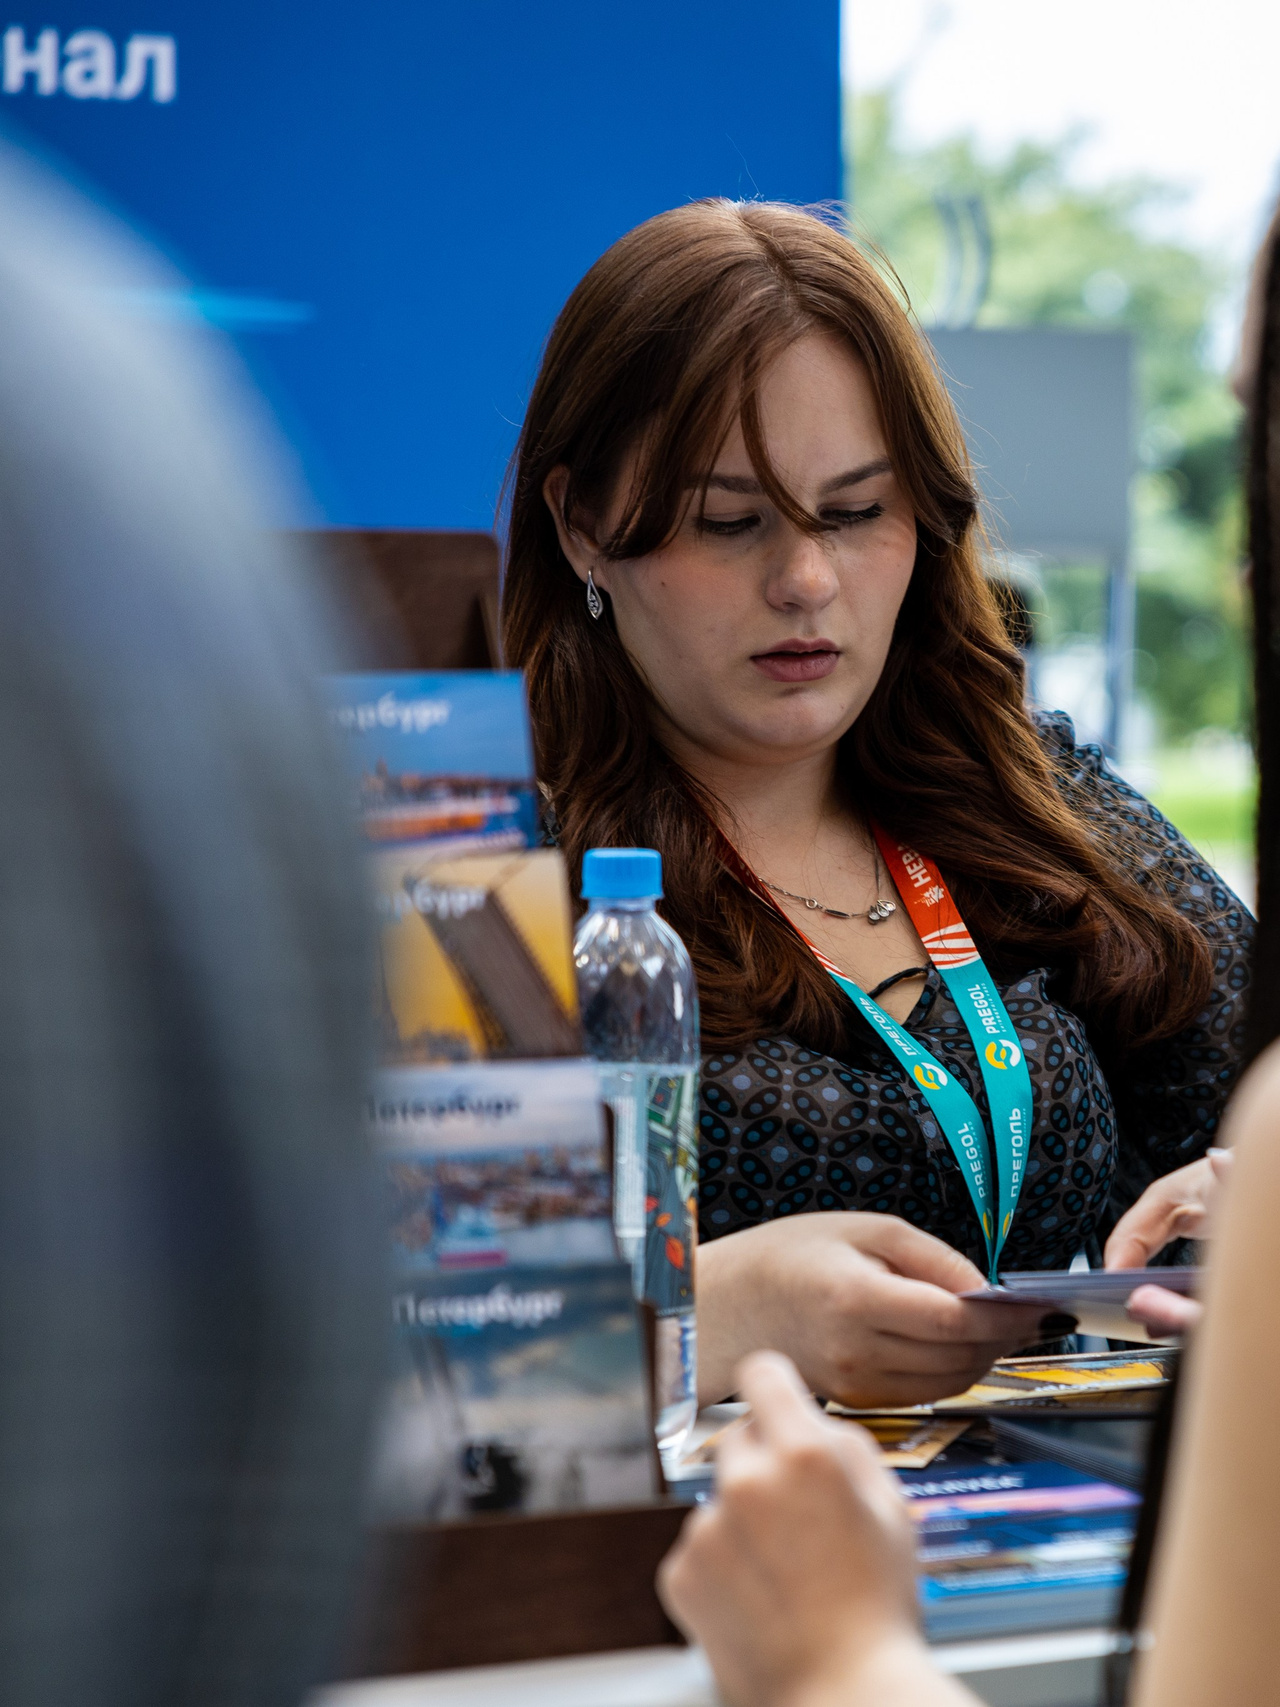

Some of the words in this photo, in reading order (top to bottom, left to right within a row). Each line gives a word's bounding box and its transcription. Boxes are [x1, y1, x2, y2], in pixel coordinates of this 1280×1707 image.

[859, 997, 918, 1056] ПРЕГОЛЬ
[967, 984, 1001, 1035] PREGOL
[957, 1122, 987, 1198] PREGOL
[1009, 1107, 1024, 1198] ПРЕГОЛЬ
